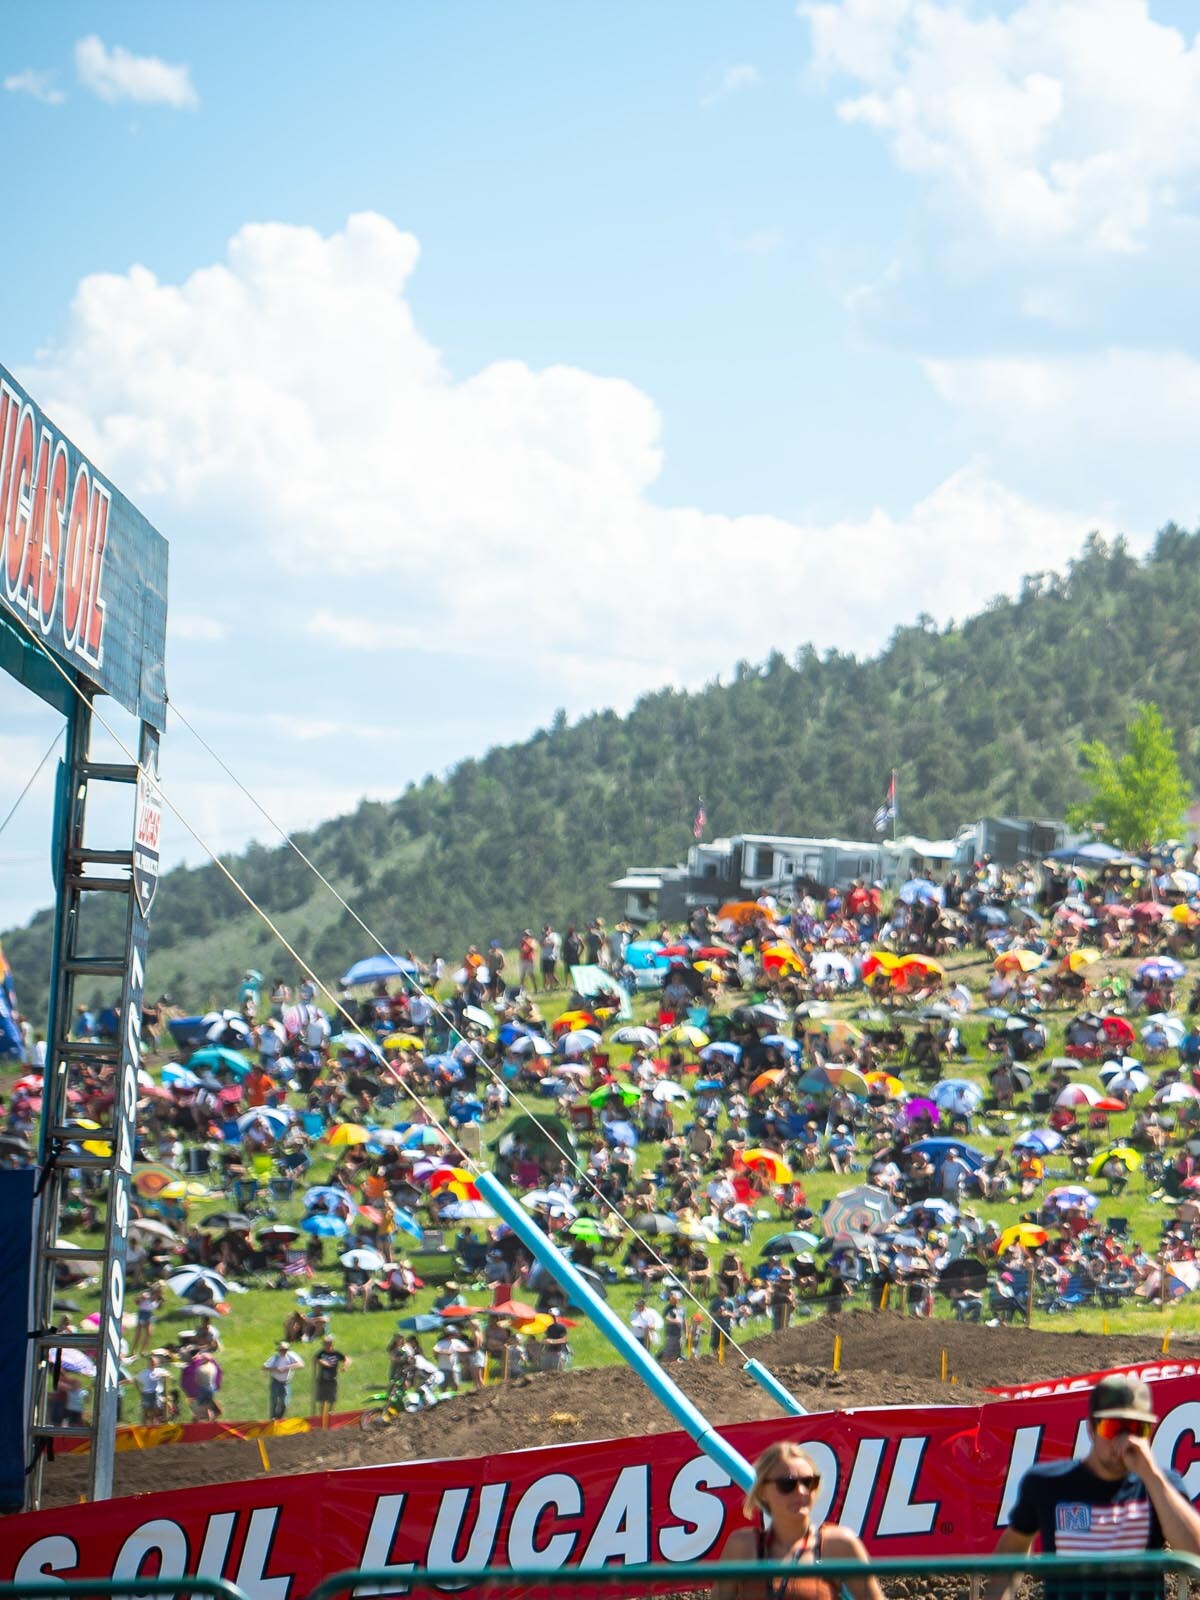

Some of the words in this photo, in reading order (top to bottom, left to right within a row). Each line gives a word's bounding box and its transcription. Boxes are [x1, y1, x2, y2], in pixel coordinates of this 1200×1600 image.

[62, 462, 111, 670] OIL
[116, 946, 143, 1237] LUCAS
[105, 1260, 123, 1391] OIL
[110, 1505, 293, 1600] OIL
[352, 1455, 734, 1598] LUCAS
